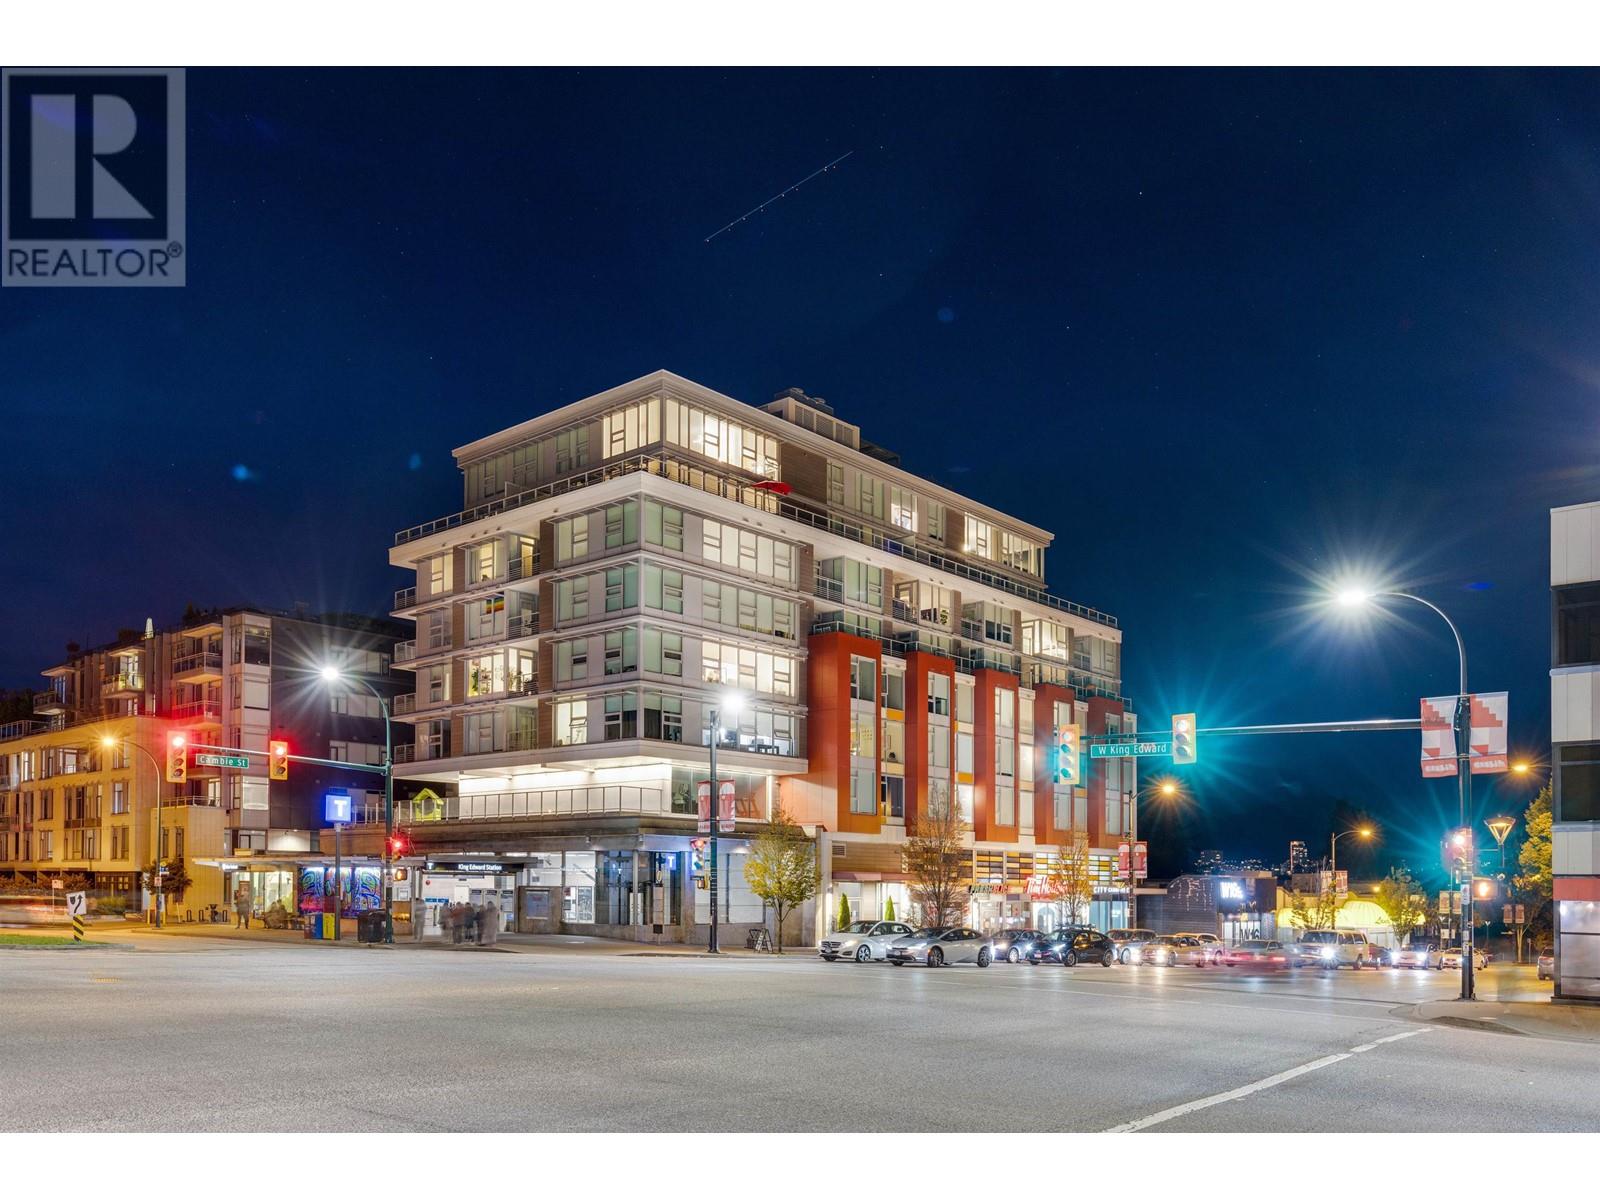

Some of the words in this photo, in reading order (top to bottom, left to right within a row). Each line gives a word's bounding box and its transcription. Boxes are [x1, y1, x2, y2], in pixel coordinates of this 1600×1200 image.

[1098, 746, 1107, 755] W
[1110, 744, 1130, 755] King
[1133, 743, 1167, 754] Edward
[200, 756, 234, 766] Cambie
[237, 758, 246, 767] St
[458, 863, 469, 871] King
[469, 863, 485, 871] Edward
[1093, 886, 1108, 894] CITY
